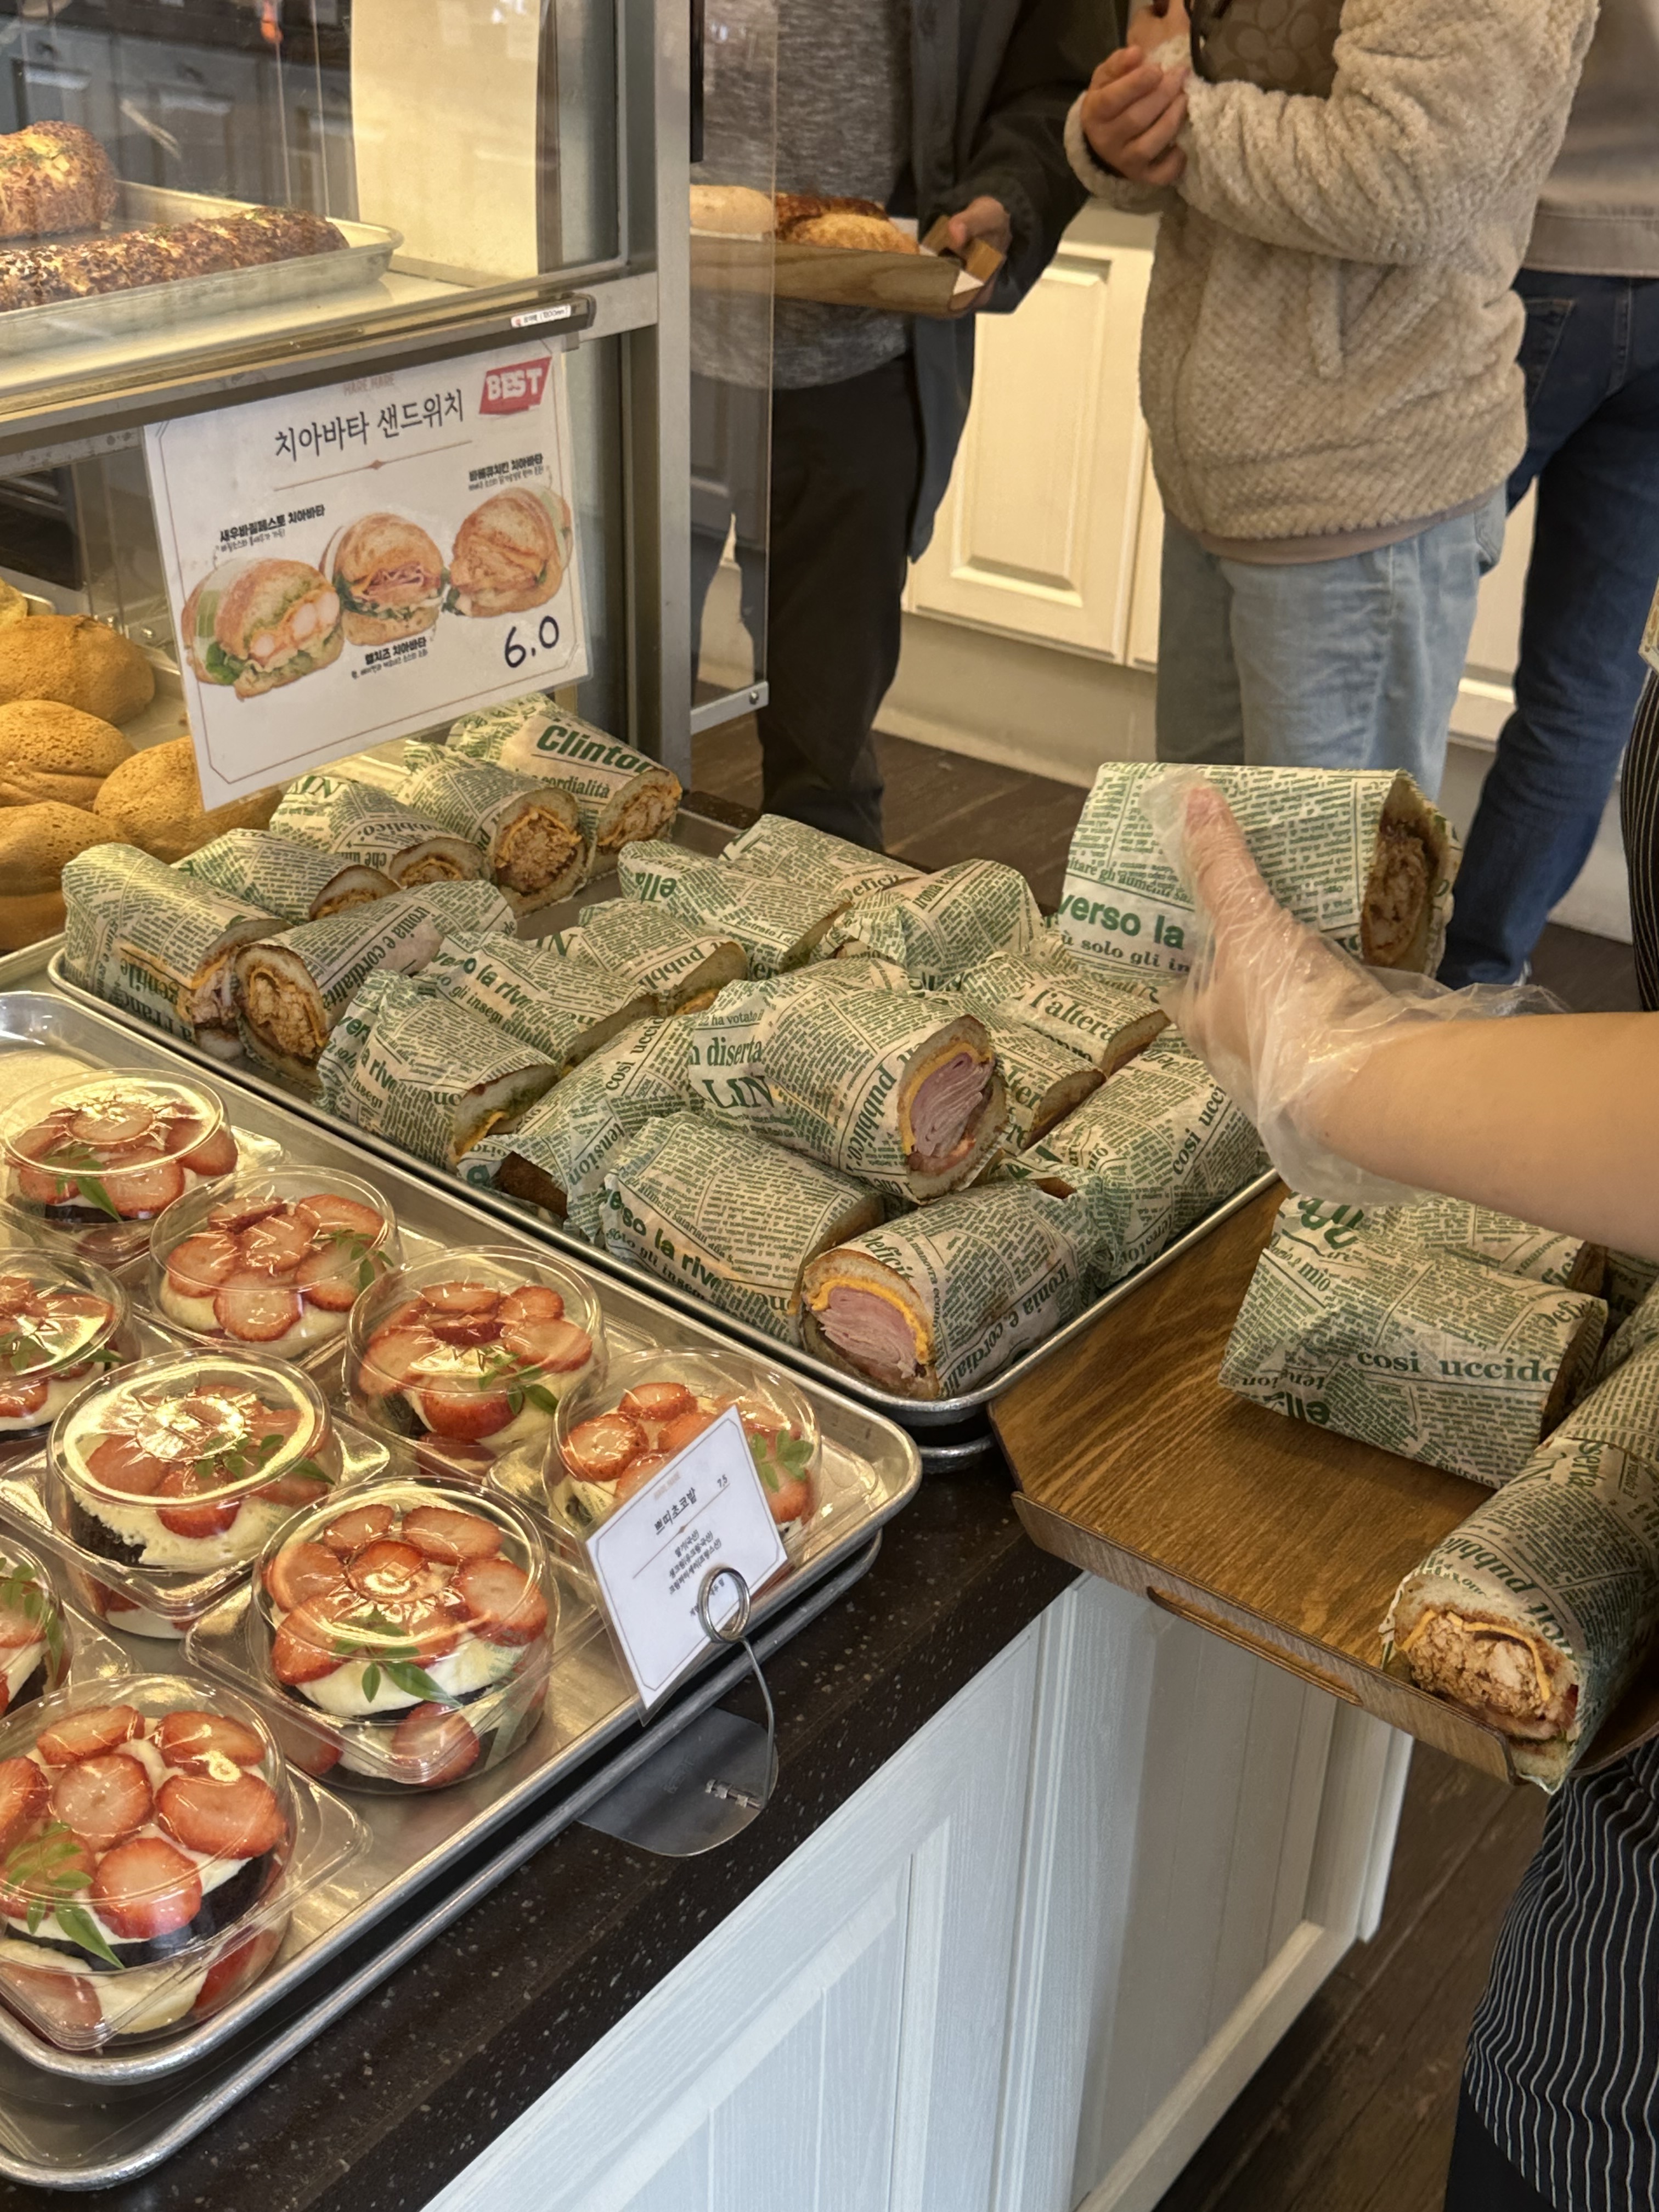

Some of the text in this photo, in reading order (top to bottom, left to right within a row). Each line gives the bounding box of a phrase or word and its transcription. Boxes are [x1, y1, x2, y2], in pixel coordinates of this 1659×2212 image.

[487, 368, 543, 400] BEST
[275, 388, 464, 462] 치아바타 샌드위치
[287, 504, 326, 523] 치아바타
[392, 636, 427, 656] 치아바타
[505, 615, 560, 668] 6.0
[391, 905, 436, 938] ironia
[1058, 894, 1185, 950] verso la
[382, 936, 397, 949] e
[1081, 939, 1124, 958] solo
[1130, 951, 1161, 967] gli
[120, 958, 179, 1006] gentile
[476, 964, 498, 988] la
[449, 985, 470, 1001] gli
[711, 1015, 725, 1026] ha
[726, 1010, 759, 1025] votato
[707, 1035, 762, 1066] diserta
[605, 1061, 636, 1091] cosi
[847, 1062, 898, 1167] pubblico:
[1172, 1127, 1202, 1175] cosi
[640, 1246, 659, 1268] gli
[654, 1228, 675, 1262] la
[1008, 1311, 1019, 1328] e
[1357, 1350, 1422, 1373] cosi
